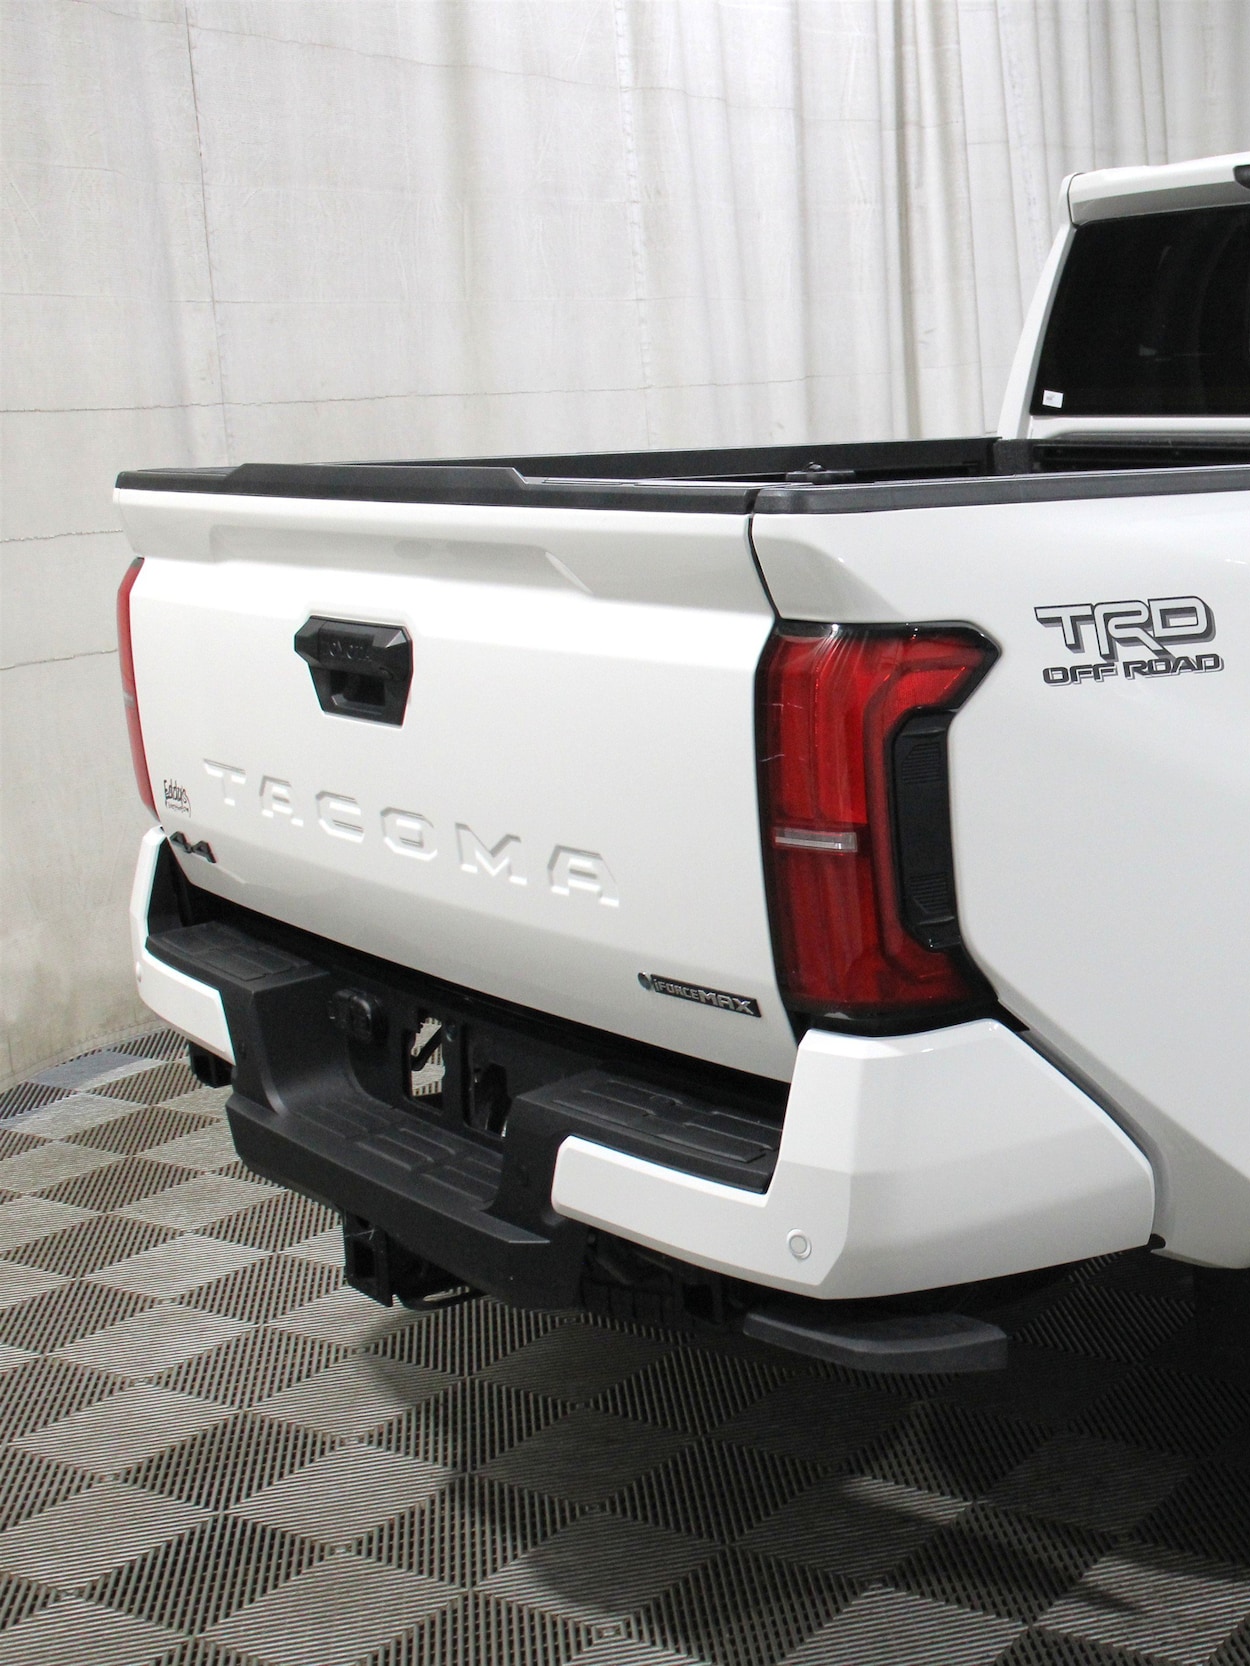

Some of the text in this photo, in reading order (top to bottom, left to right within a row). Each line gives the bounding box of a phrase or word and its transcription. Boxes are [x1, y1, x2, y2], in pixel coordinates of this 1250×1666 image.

[1034, 596, 1216, 662] TRD
[1043, 653, 1224, 686] OFF ROAD
[203, 758, 620, 907] TACOMA
